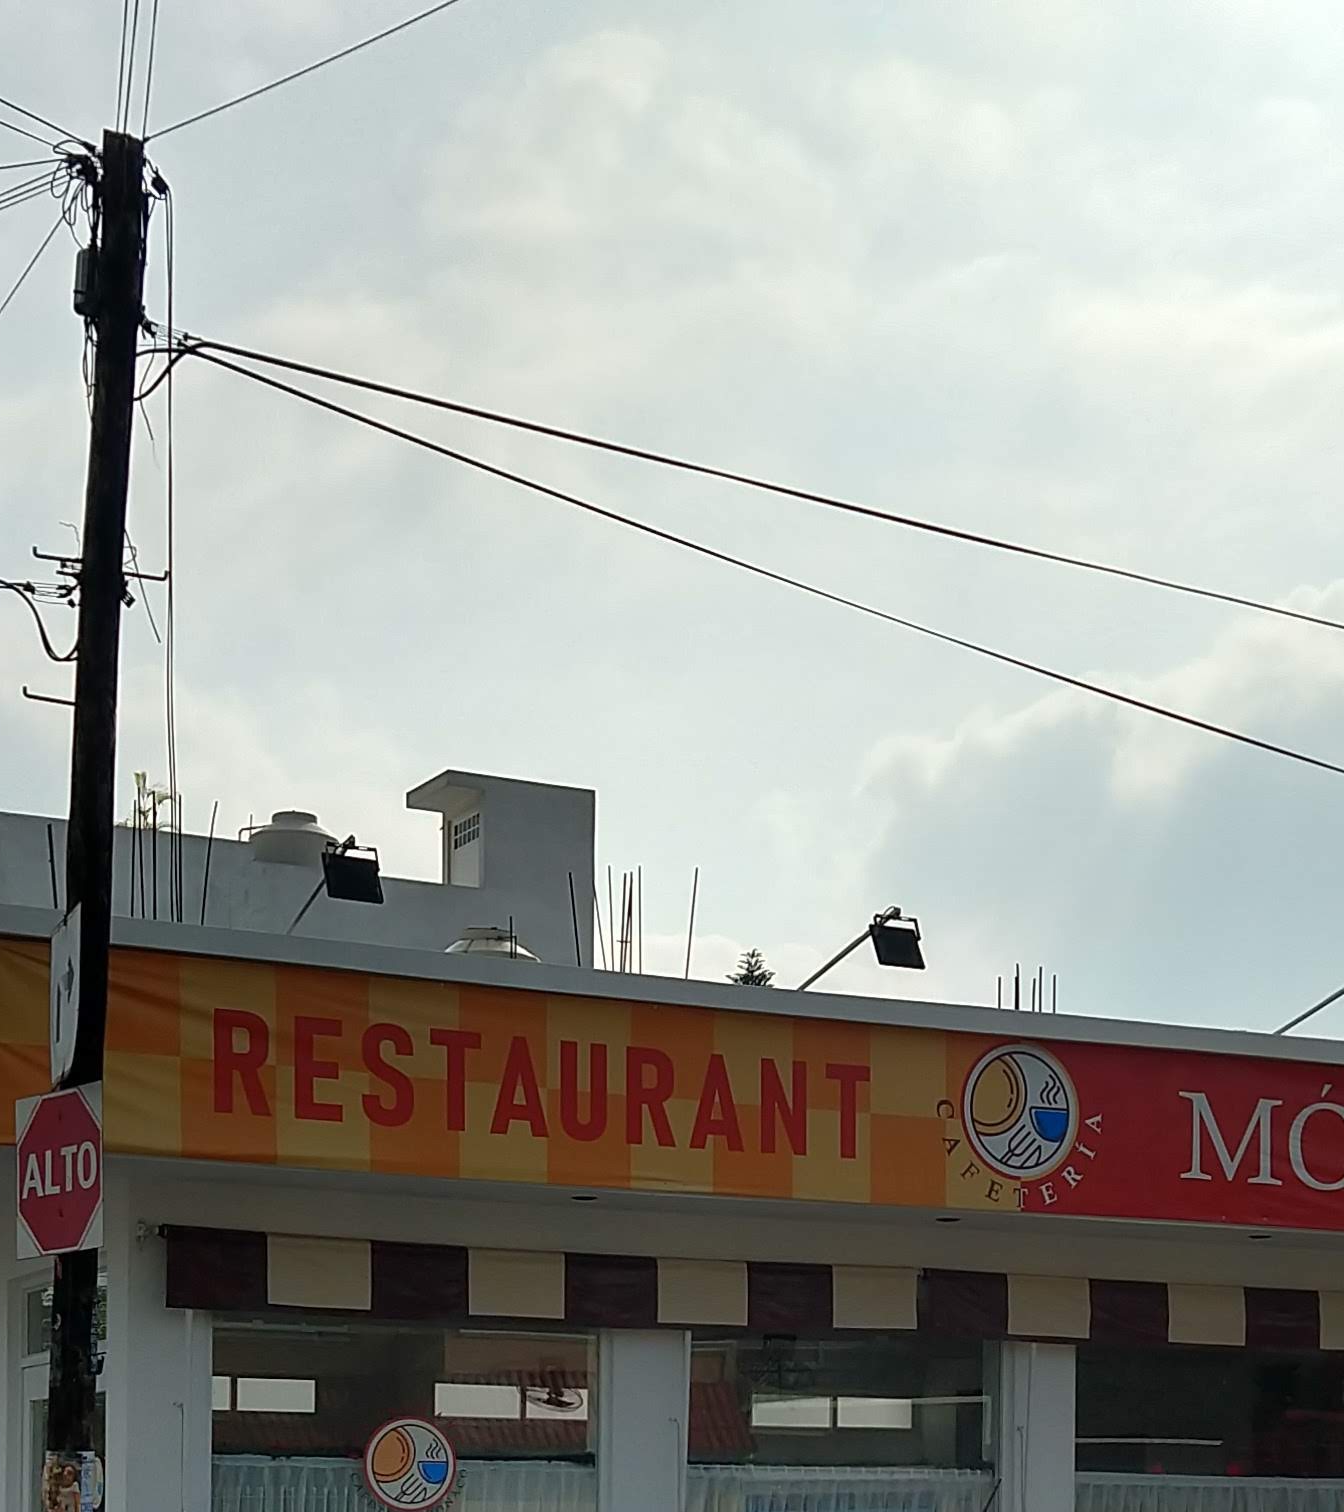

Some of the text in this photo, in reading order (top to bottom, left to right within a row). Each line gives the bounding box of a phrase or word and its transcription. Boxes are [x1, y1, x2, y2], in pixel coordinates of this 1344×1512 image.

[212, 1007, 871, 1158] RESTAURANT
[21, 1141, 98, 1200] ALTO
[935, 1099, 1104, 1210] CAFETERÍA
